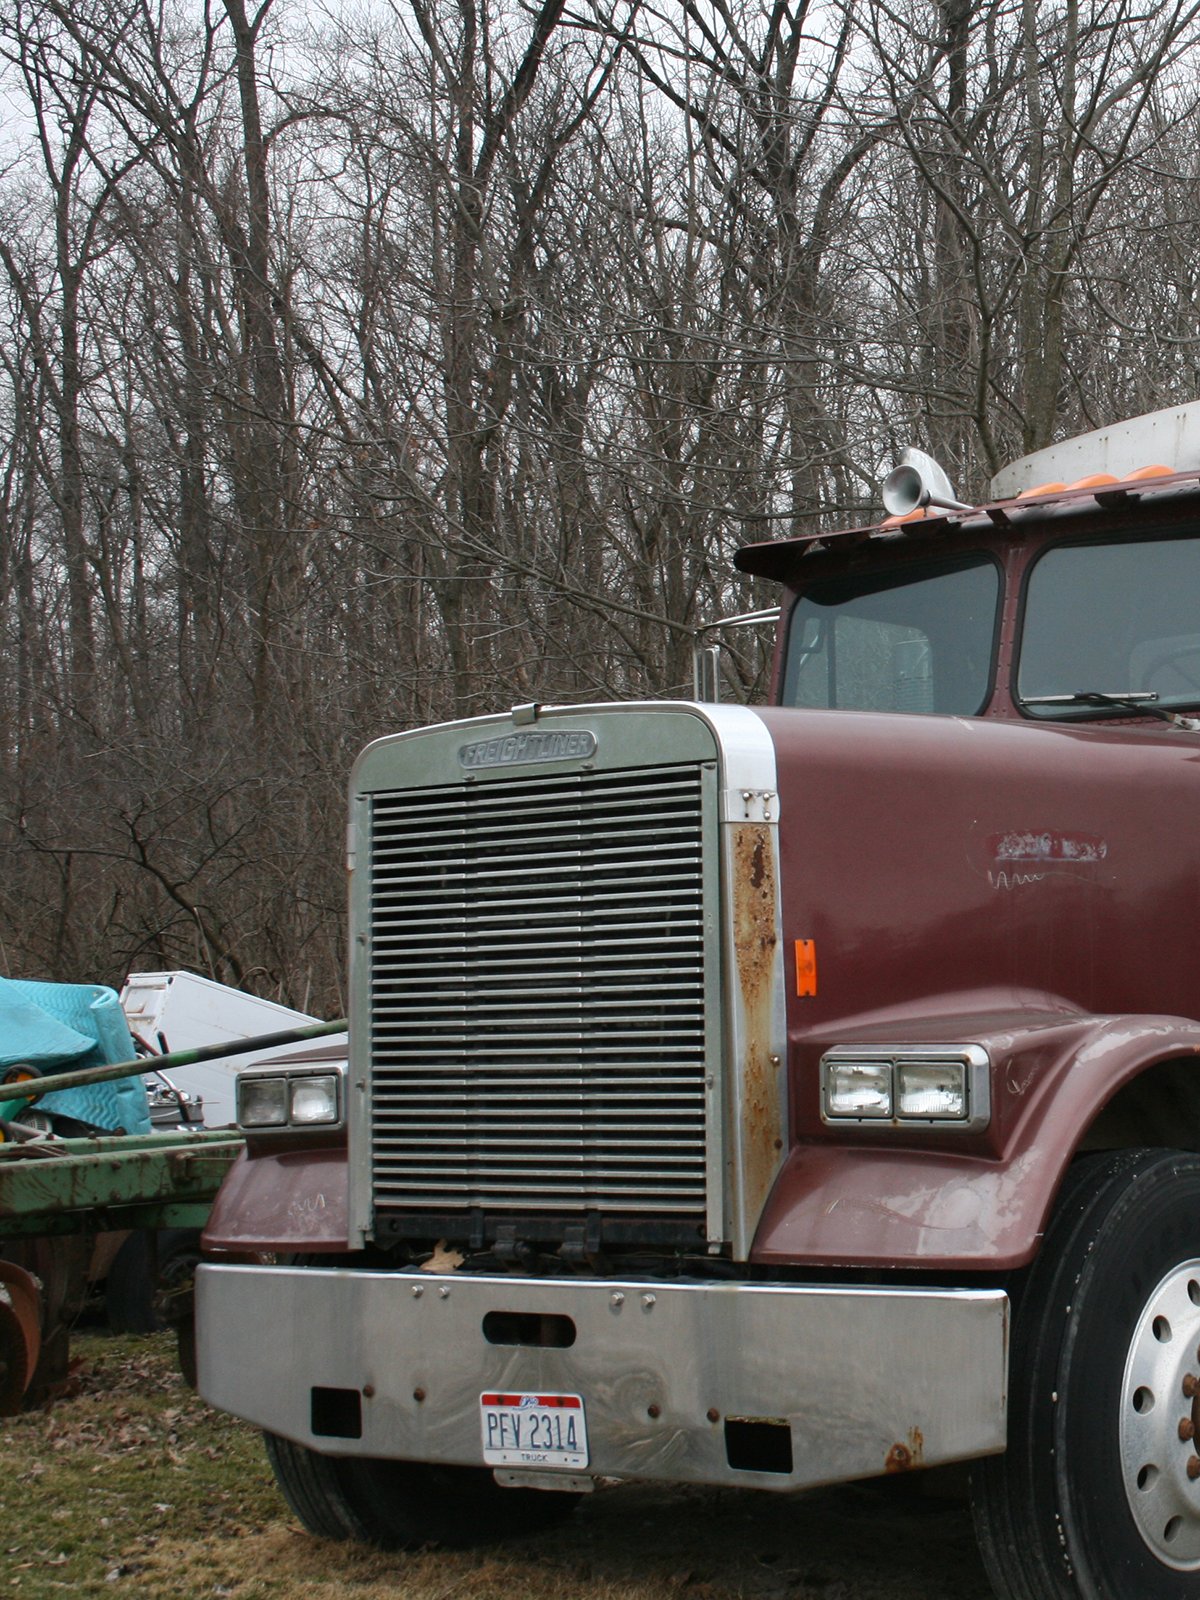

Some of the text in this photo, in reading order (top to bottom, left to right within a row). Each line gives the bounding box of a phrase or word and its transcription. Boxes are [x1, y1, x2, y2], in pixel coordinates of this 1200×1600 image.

[464, 734, 590, 765] FREIGHTLINER
[487, 1412, 578, 1450] PFV 2314
[521, 1453, 549, 1462] TRUCK
